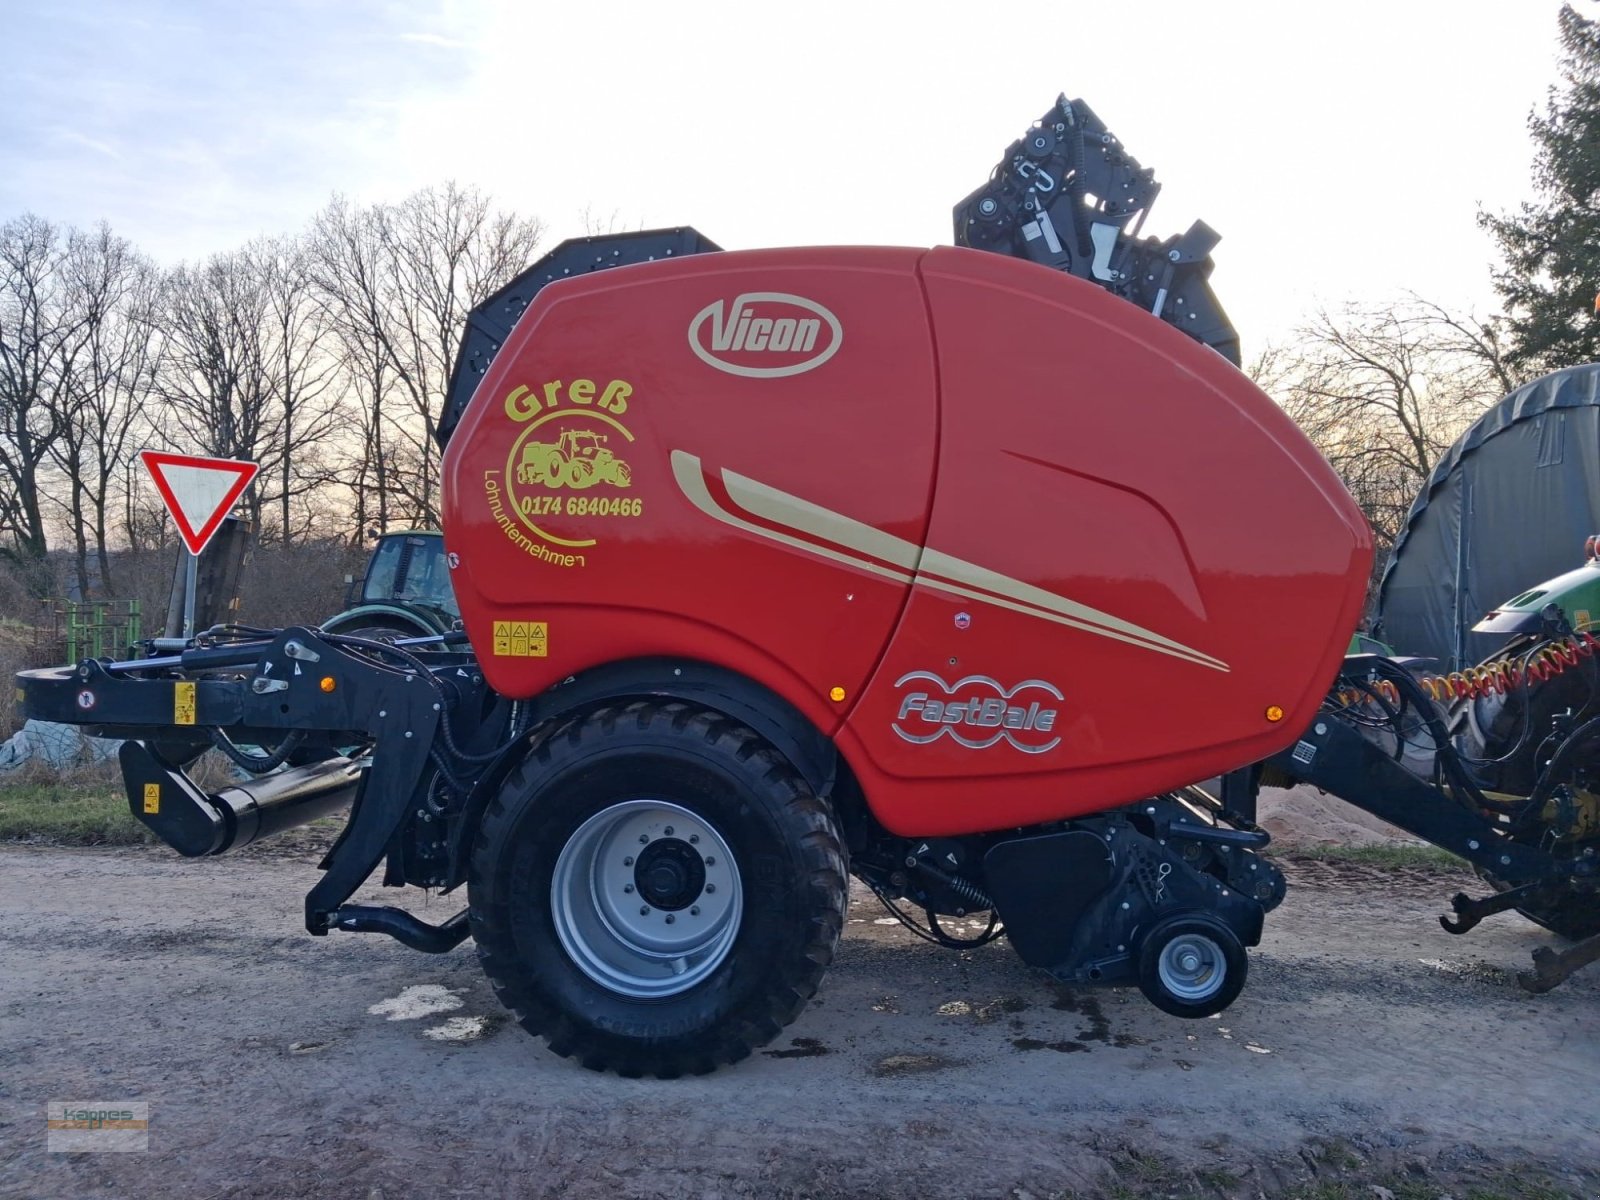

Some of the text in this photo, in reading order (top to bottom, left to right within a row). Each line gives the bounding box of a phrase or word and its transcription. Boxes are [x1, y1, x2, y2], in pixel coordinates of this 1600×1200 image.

[711, 296, 821, 352] Vicon
[504, 379, 633, 422] Greß
[484, 469, 585, 568] Lohnunternehmen
[521, 496, 643, 517] 0174 6840466
[897, 692, 1057, 732] FastBale
